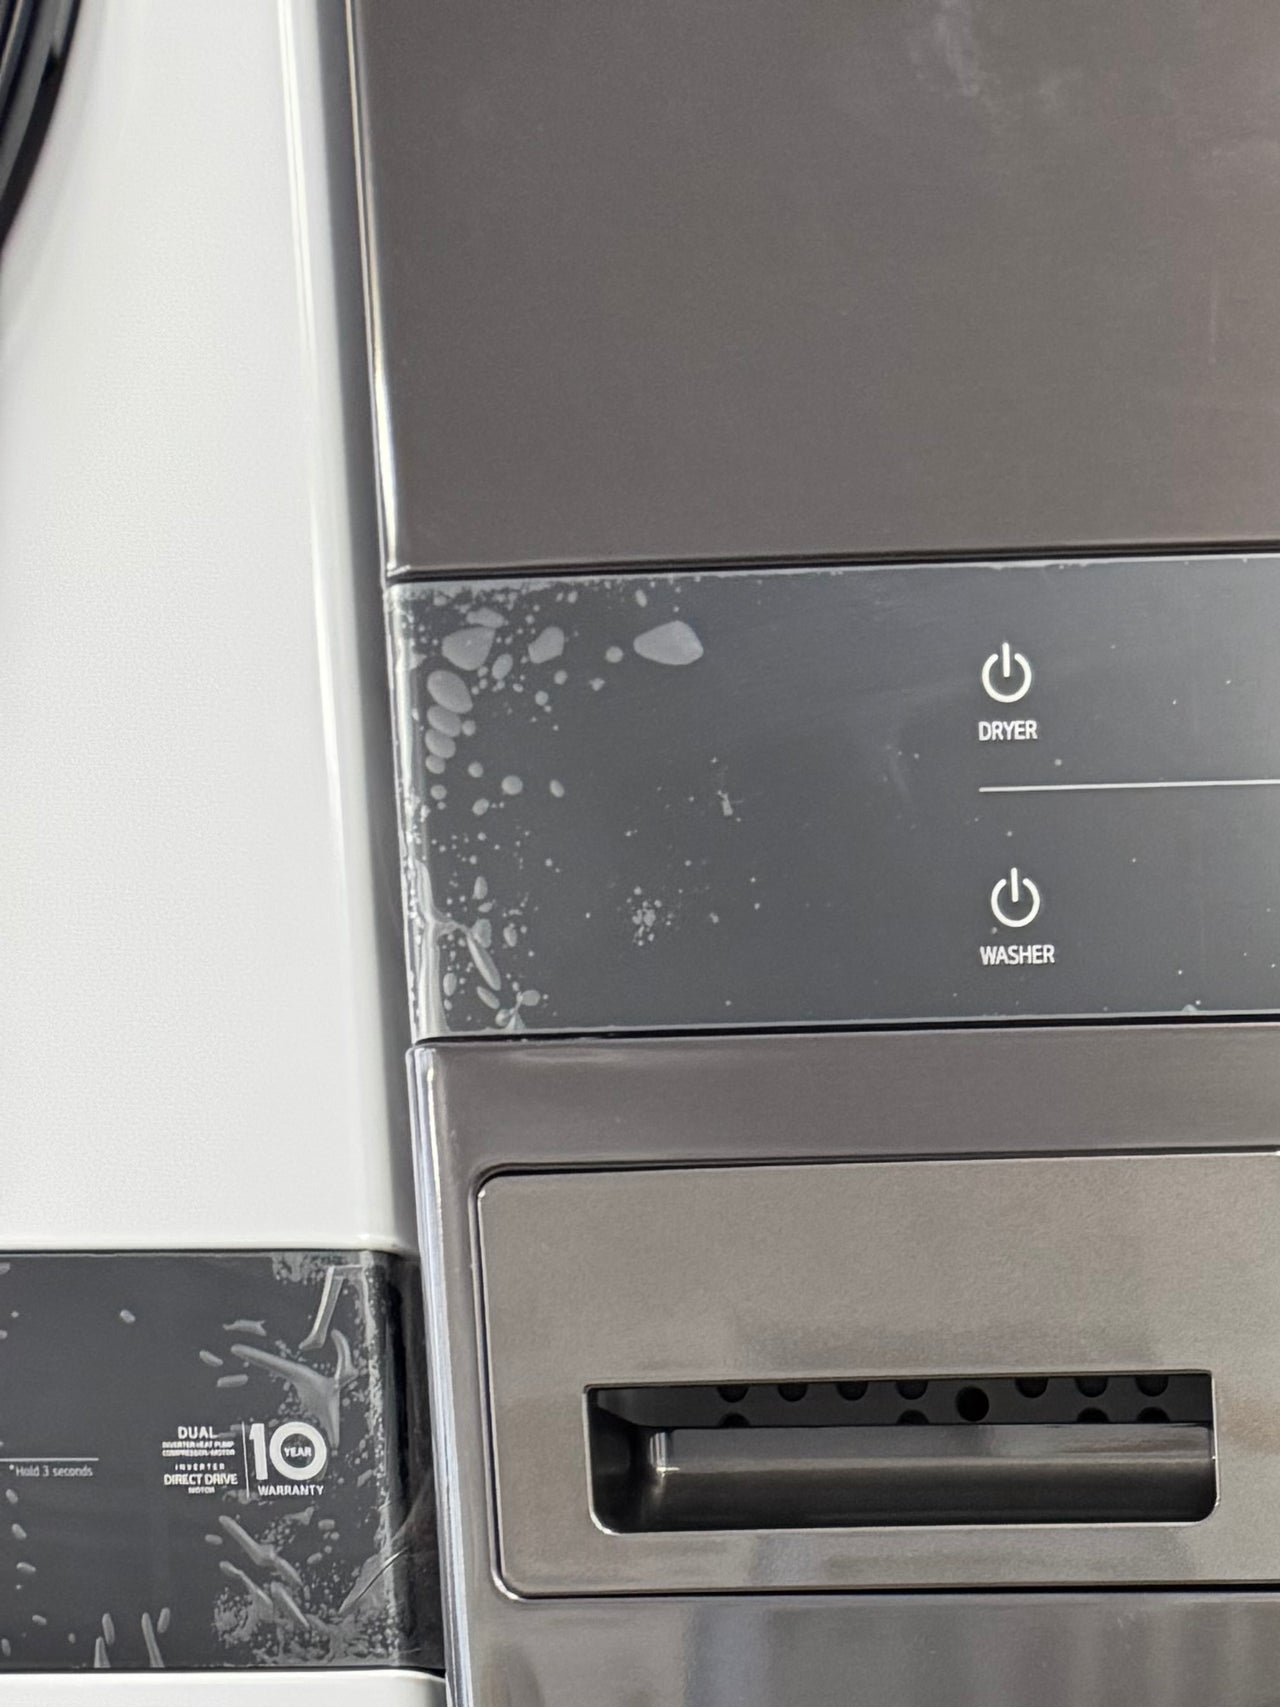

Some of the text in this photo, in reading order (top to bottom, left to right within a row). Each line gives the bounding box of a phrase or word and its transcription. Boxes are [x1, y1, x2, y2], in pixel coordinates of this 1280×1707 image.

[979, 720, 1038, 741] DRYER
[980, 944, 1055, 965] WASHER
[177, 1425, 219, 1440] DUAL
[248, 1420, 328, 1481] 10
[283, 1446, 313, 1458] YEAR
[43, 1465, 49, 1477] 3
[53, 1465, 93, 1476] seconds
[163, 1472, 239, 1486] DIRECT DRIVE
[257, 1484, 325, 1497] WARRANTY
